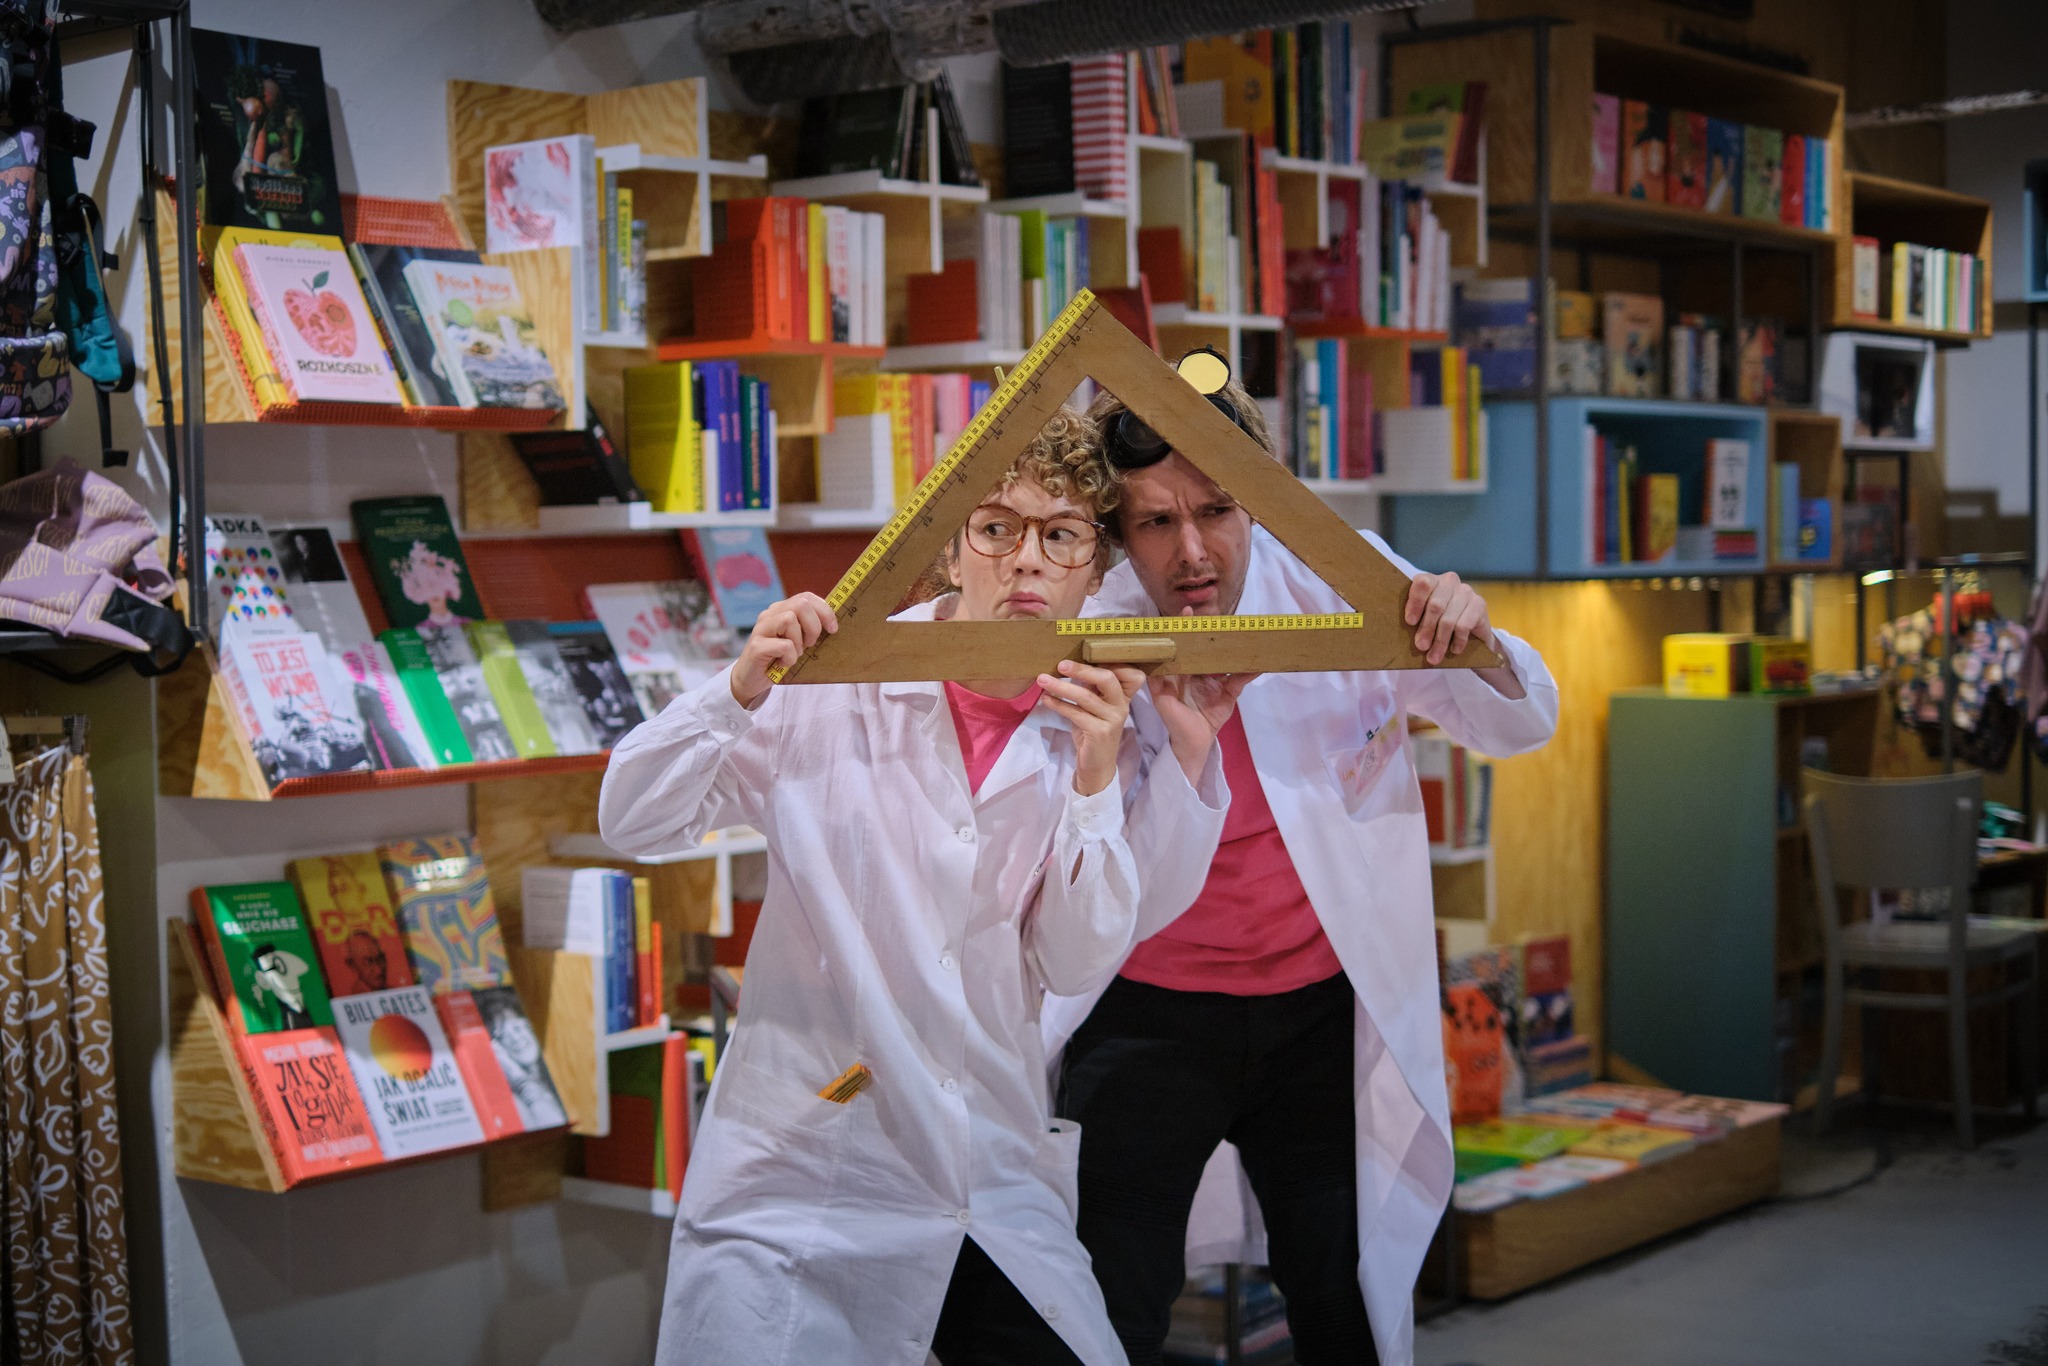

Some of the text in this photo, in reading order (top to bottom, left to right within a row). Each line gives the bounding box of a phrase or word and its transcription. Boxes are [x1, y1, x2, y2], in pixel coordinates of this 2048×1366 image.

[296, 358, 384, 376] ROZKOSZNE
[252, 646, 308, 674] TO JEST
[222, 916, 298, 936] SŁUCHASZ
[343, 992, 427, 1024] BILL GATES
[373, 1060, 456, 1098] JAK OCALIĆ
[383, 1096, 431, 1126] ŚWIAT
